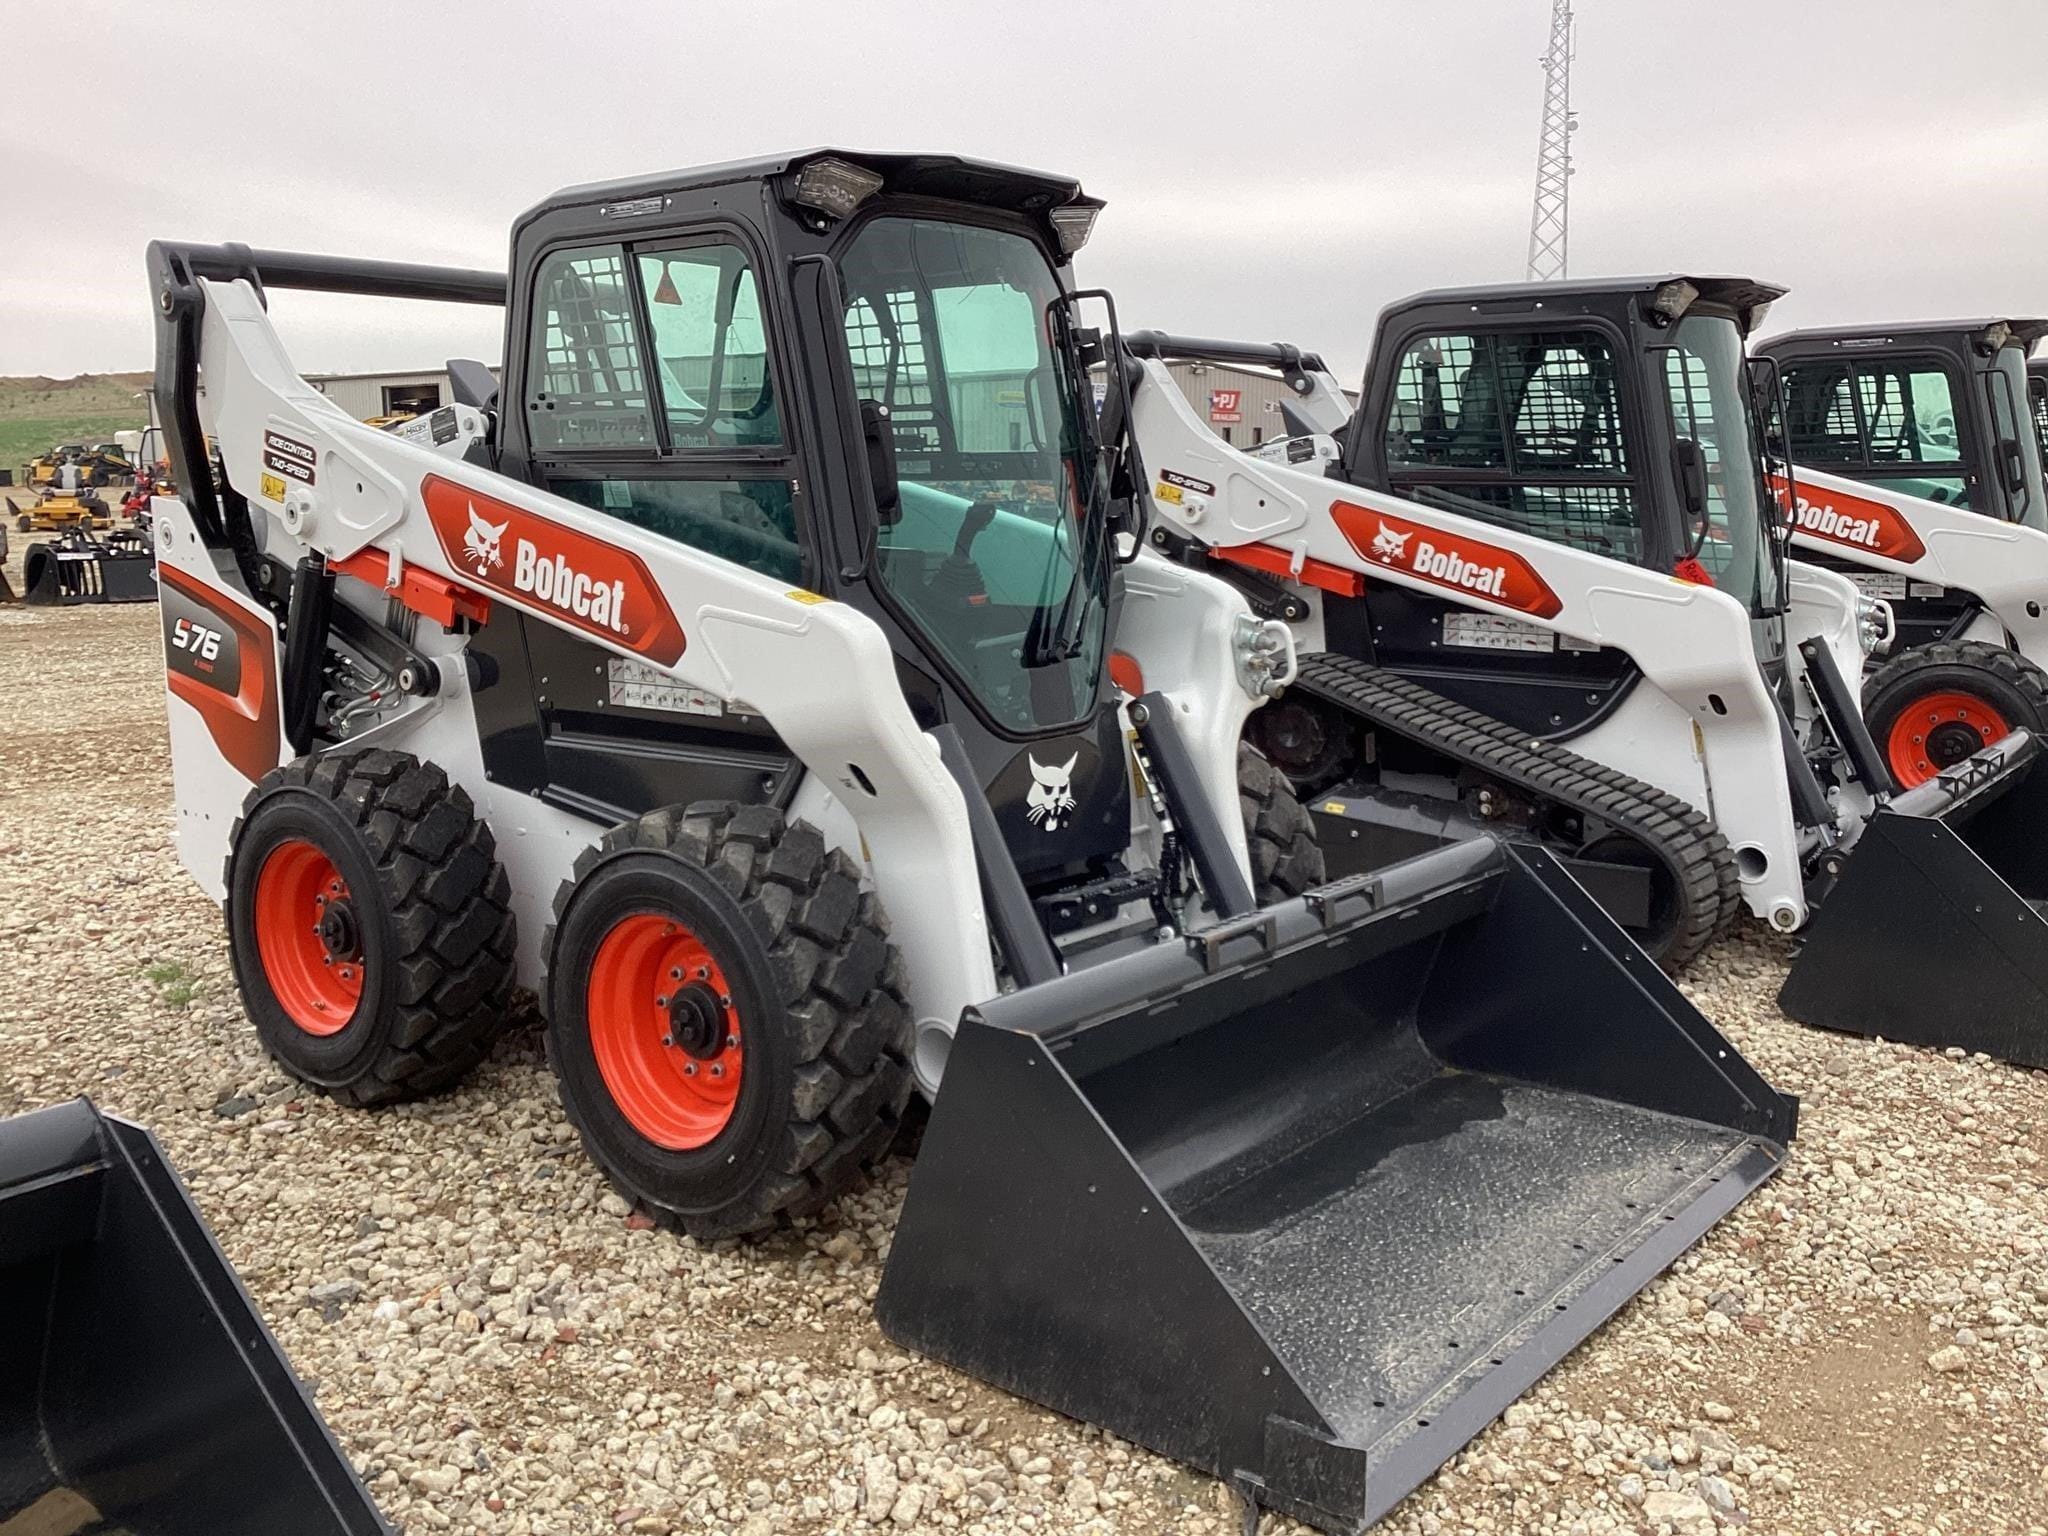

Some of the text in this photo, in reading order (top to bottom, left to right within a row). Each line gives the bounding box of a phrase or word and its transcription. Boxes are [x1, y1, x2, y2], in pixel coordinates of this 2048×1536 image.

[1218, 393, 1237, 409] PJ
[268, 435, 313, 460] RIDE CONTROL
[270, 457, 310, 479] TWO-SPEED
[1167, 473, 1210, 492] TWO-SPEED
[1786, 496, 1880, 546] Bobcat
[514, 538, 625, 633] Bobcat
[1412, 541, 1506, 597] Bobcat
[172, 618, 222, 661] S76
